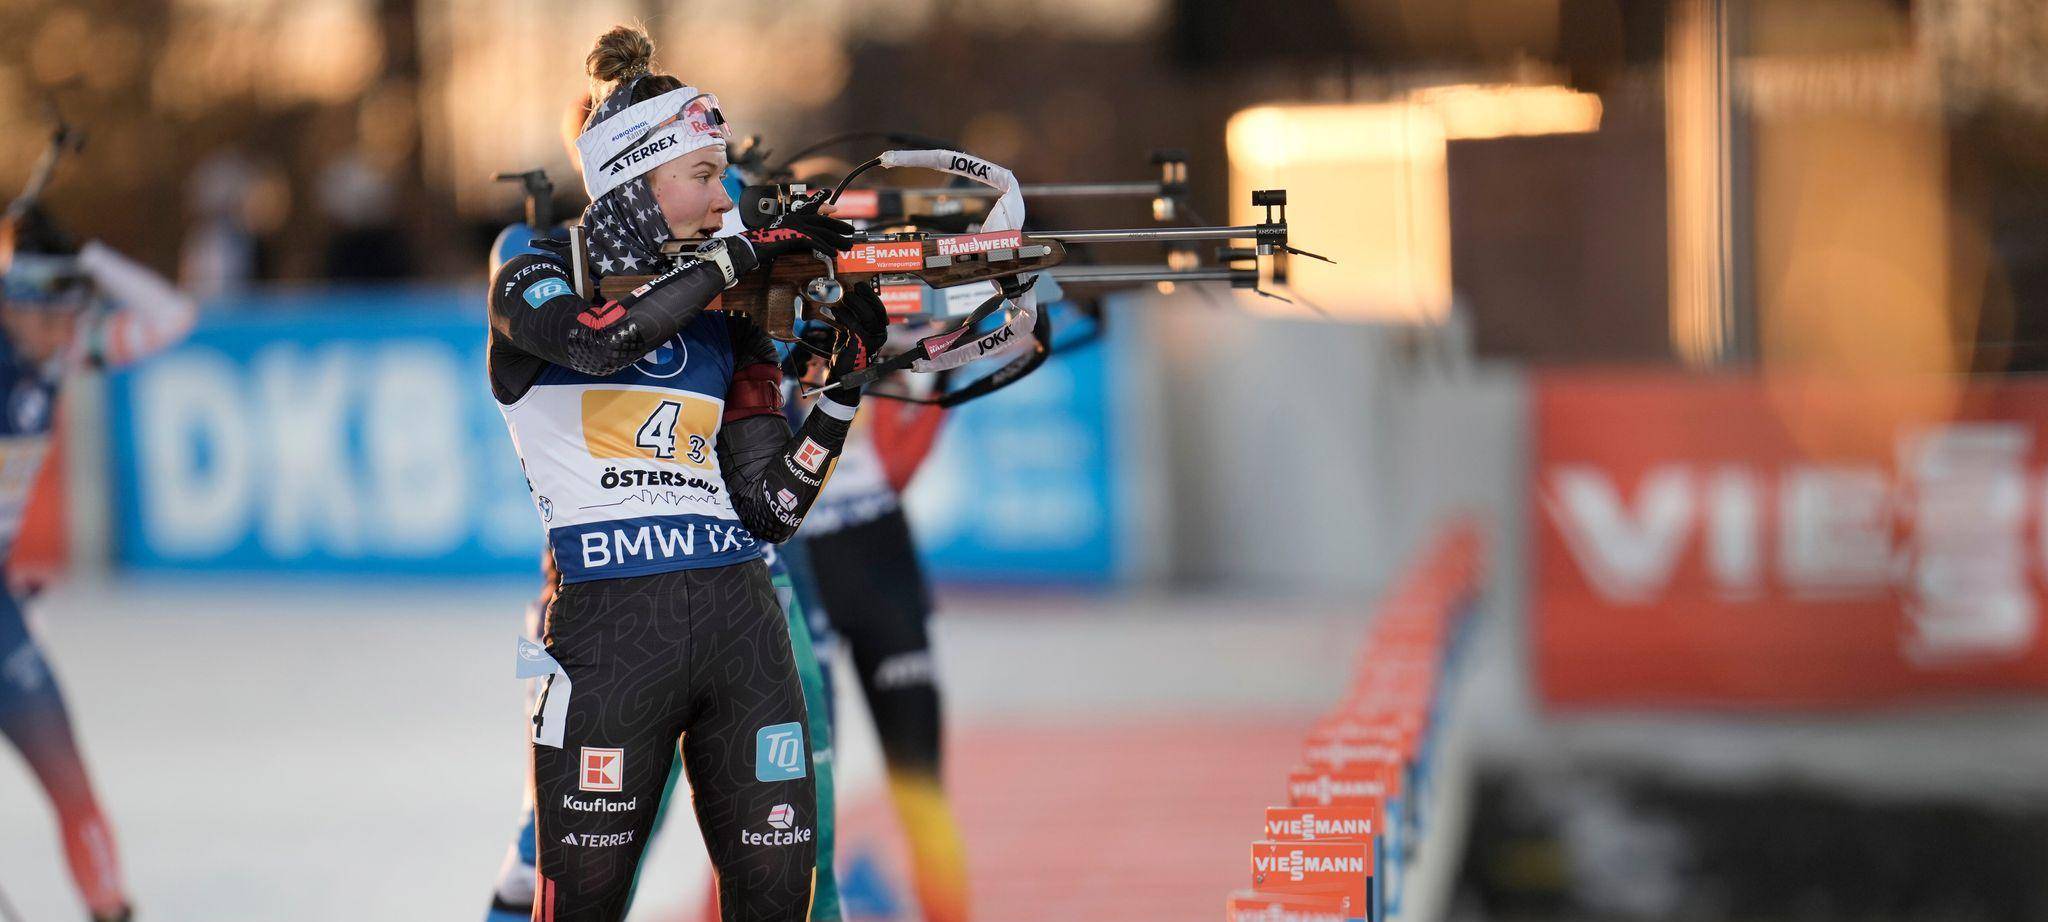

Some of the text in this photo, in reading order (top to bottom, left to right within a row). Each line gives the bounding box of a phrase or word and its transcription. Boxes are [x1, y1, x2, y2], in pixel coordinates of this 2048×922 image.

[623, 133, 679, 167] TERREX
[949, 155, 989, 180] JOKA
[840, 245, 920, 264] VIESSMANN
[939, 238, 956, 246] DAS
[513, 262, 569, 281] TERRE
[649, 259, 704, 286] Kauflan
[978, 324, 1014, 356] JOKA
[636, 400, 706, 464] 4 3
[138, 338, 468, 560] DKB
[783, 451, 823, 487] Kaufland
[762, 479, 803, 527] tectake
[581, 523, 694, 568] BMW
[563, 794, 637, 812] Kaufland
[580, 829, 635, 848] TERREX
[741, 826, 812, 846] tectake
[1268, 813, 1372, 841] VIESSMANN
[1254, 850, 1363, 881] VIESSMANN
